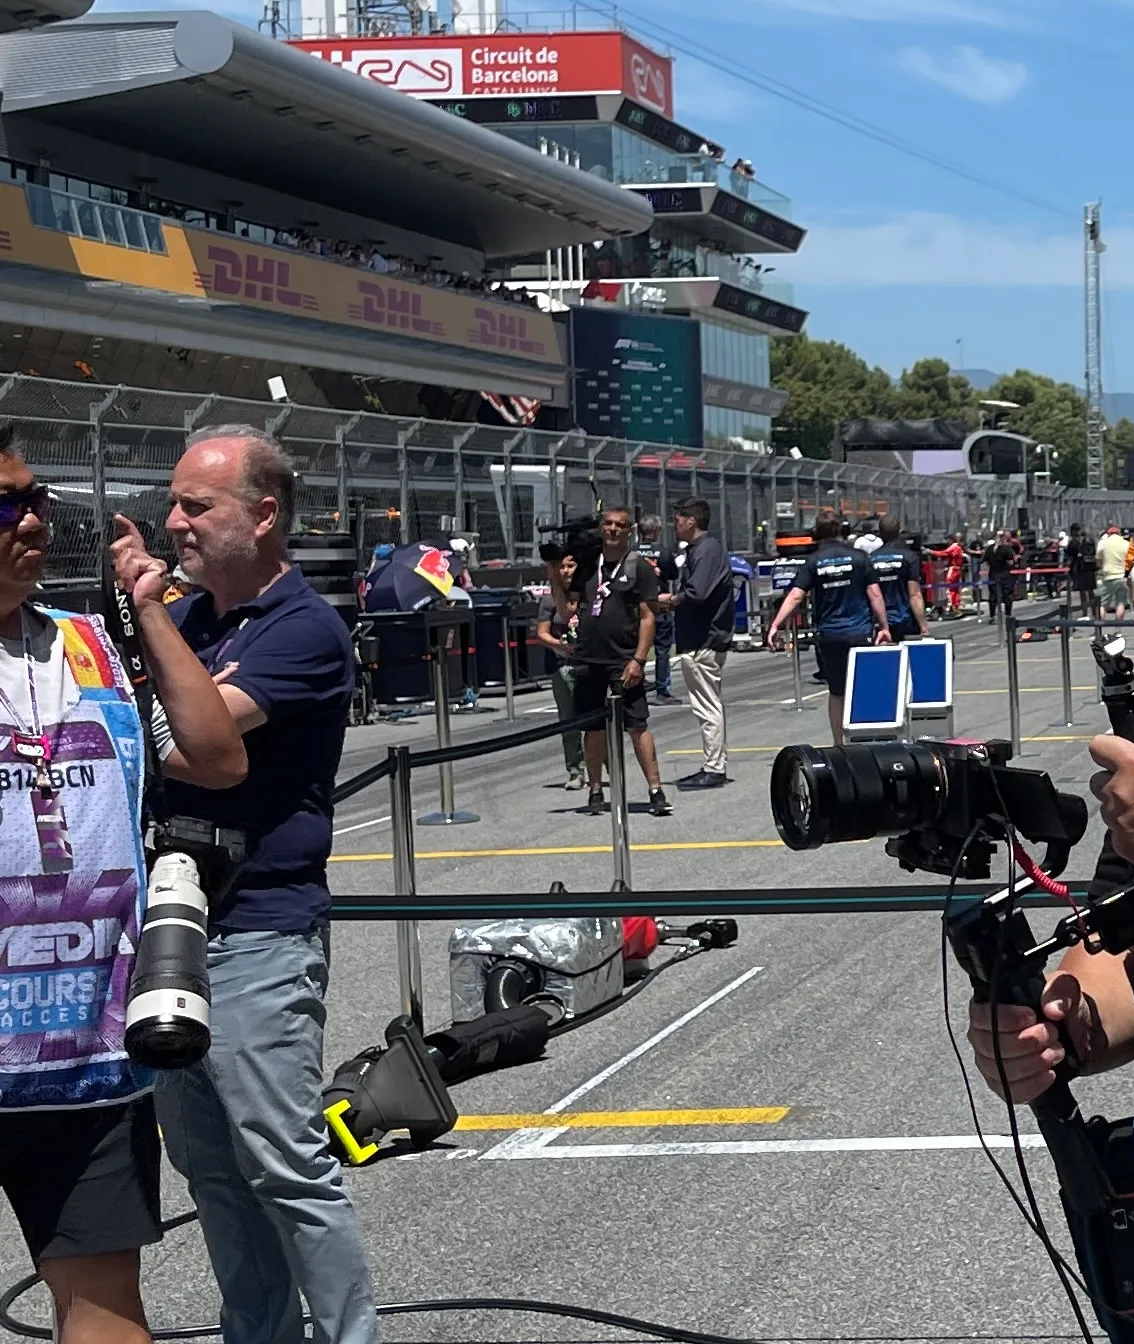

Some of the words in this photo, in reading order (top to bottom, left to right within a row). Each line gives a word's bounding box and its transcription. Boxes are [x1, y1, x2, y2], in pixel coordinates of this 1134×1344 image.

[471, 46, 533, 65] Circuit
[536, 46, 559, 64] de
[471, 66, 559, 84] Barcelona
[206, 244, 305, 308] DHL
[357, 279, 433, 334] DHL
[474, 307, 535, 353] DHL
